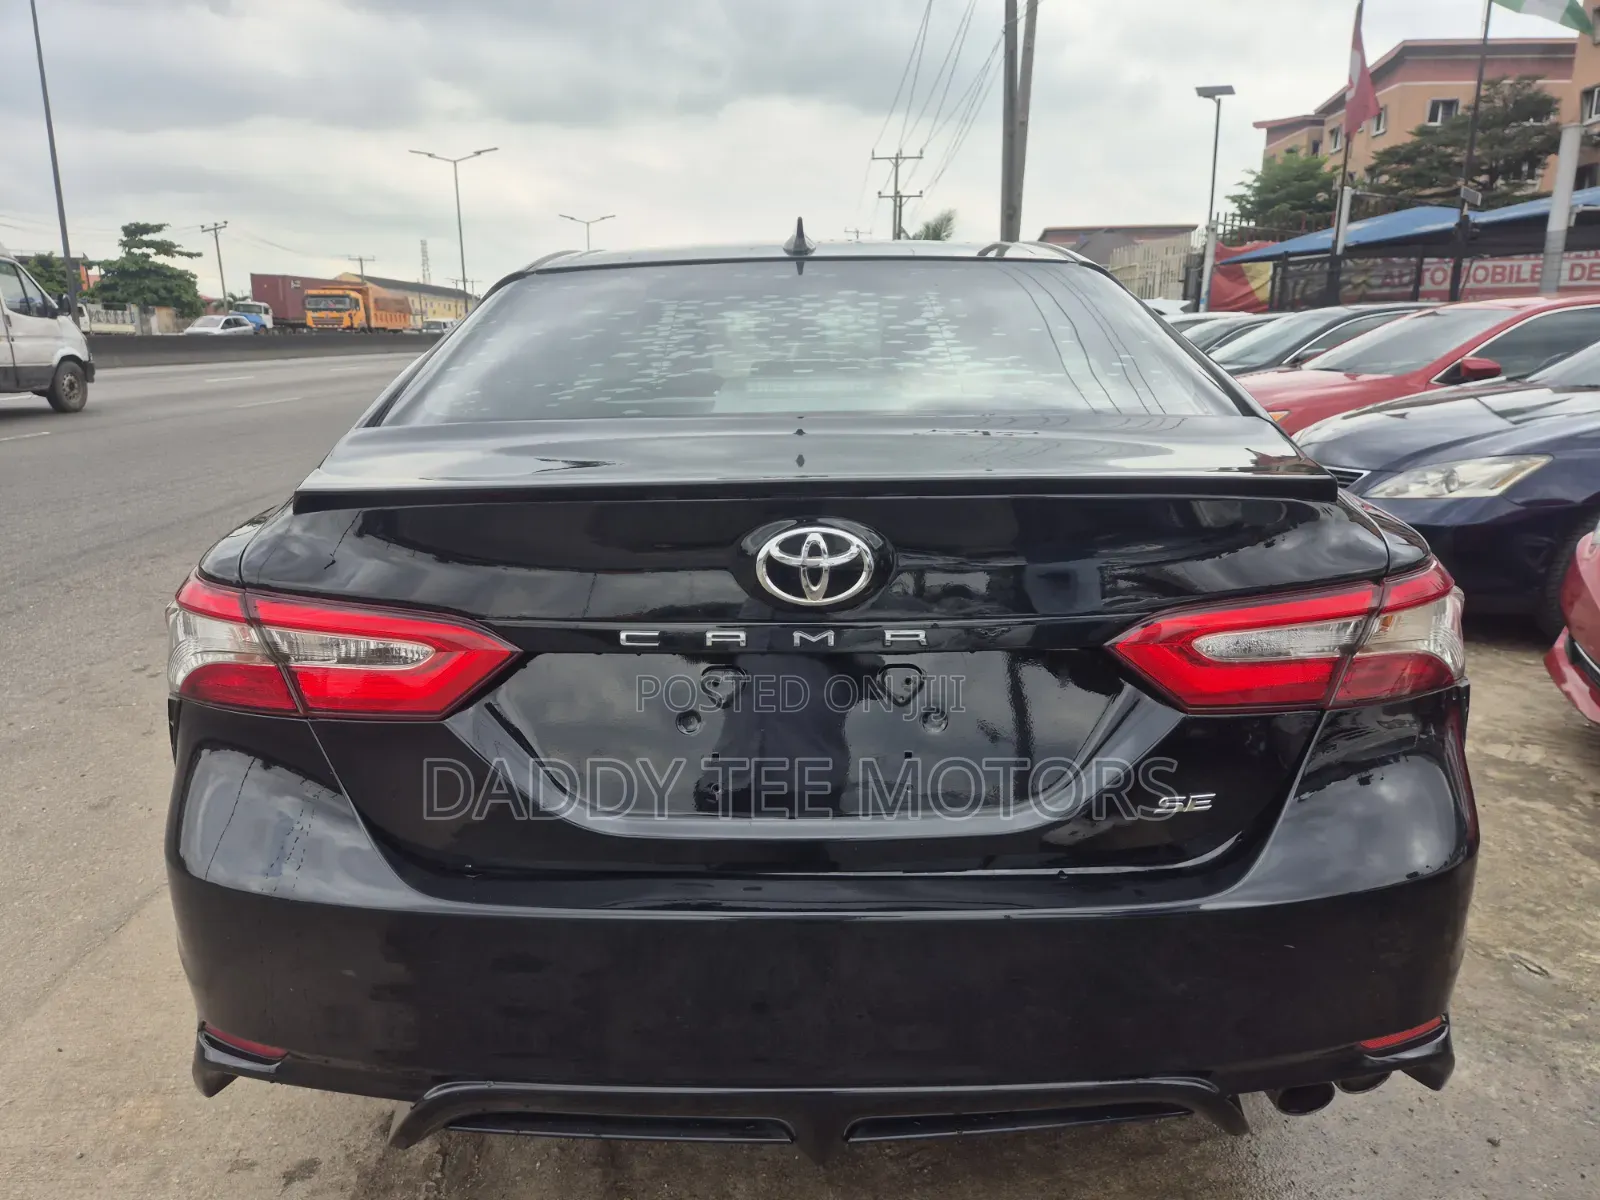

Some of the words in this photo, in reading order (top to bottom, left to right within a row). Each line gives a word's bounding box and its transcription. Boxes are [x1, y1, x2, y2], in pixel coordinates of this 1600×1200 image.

[1568, 262, 1600, 282] DE
[619, 629, 927, 646] CAMR
[1153, 793, 1216, 814] SE
